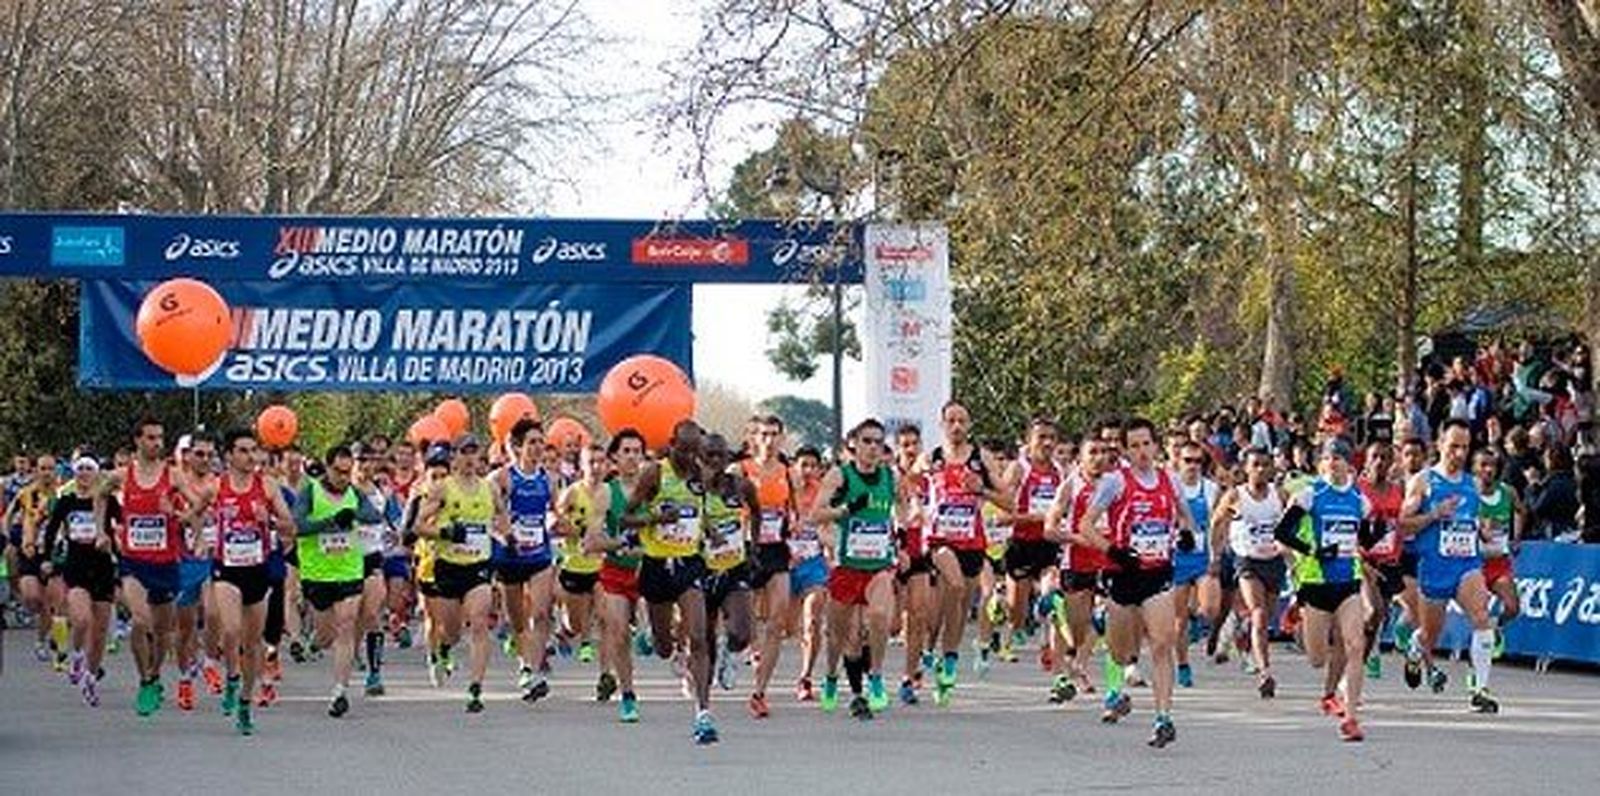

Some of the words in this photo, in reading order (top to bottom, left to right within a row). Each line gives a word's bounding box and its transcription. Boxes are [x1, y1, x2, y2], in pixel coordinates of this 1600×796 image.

[189, 239, 240, 257] asics
[401, 222, 524, 255] MARATÓN
[556, 242, 606, 261] asics
[300, 253, 359, 275] asics
[362, 255, 405, 274] VILLA
[410, 257, 429, 274] DE
[430, 257, 484, 275] MADRID
[485, 258, 520, 275] 2013
[391, 300, 592, 353] MARATÓN
[226, 354, 328, 381] asics
[337, 355, 397, 383] VILLA
[402, 356, 433, 383] DE
[435, 357, 525, 385] MADRID
[530, 357, 585, 384] 2013
